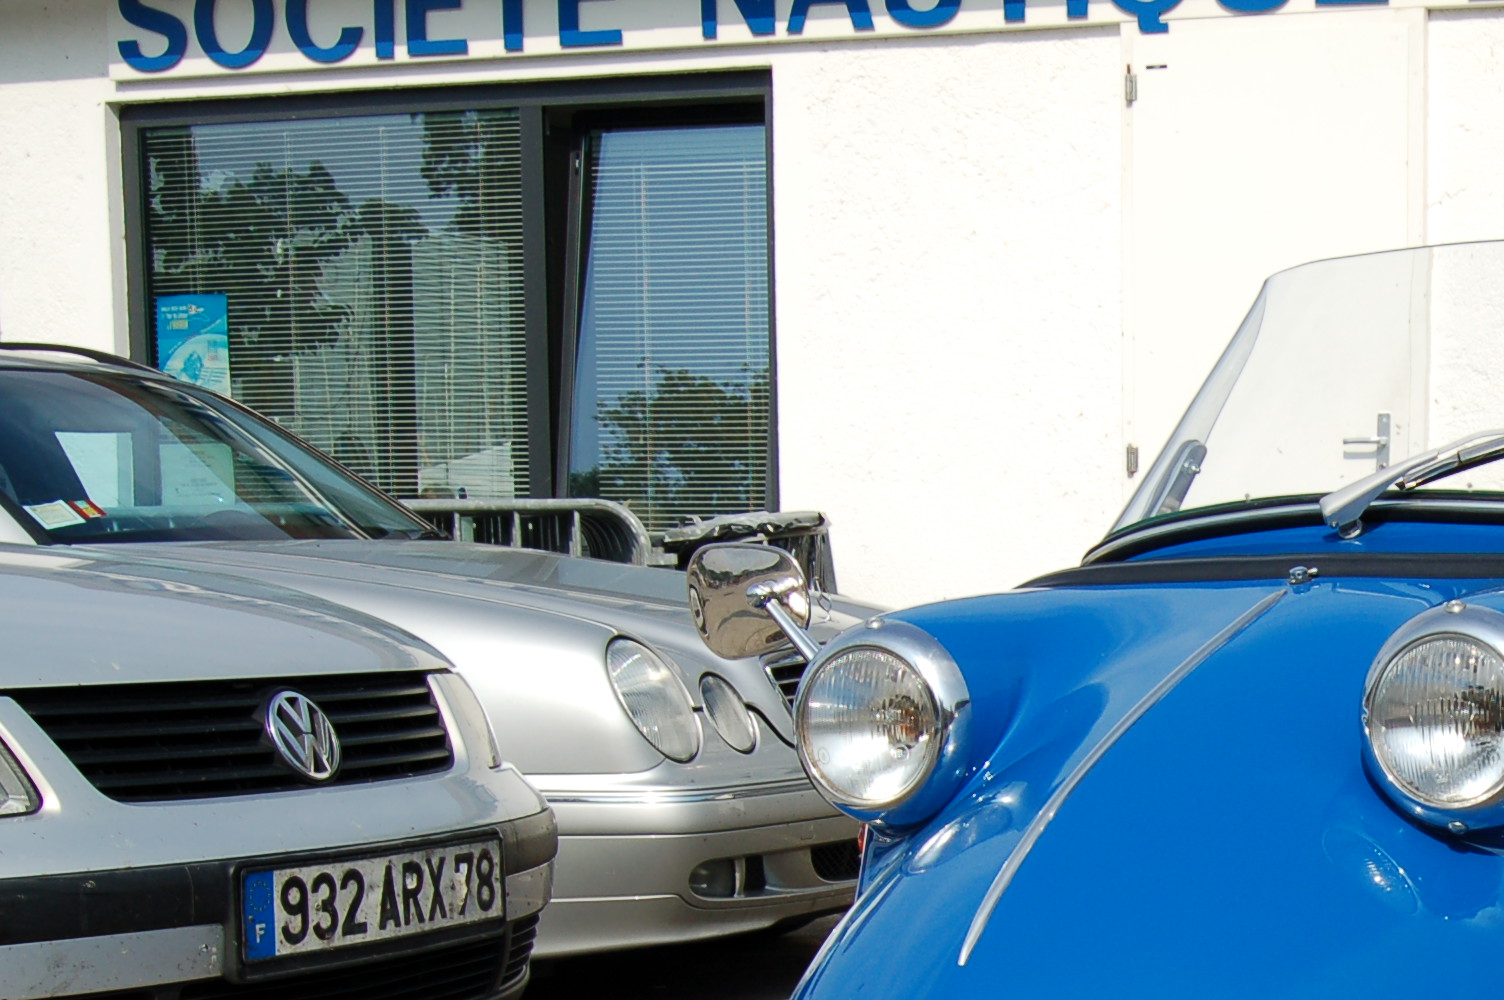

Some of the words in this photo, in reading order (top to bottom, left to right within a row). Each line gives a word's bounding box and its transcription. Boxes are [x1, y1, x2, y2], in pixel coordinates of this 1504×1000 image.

[280, 868, 368, 945] 932
[379, 856, 447, 931] ARX
[454, 849, 496, 916] 78
[255, 923, 267, 944] F
